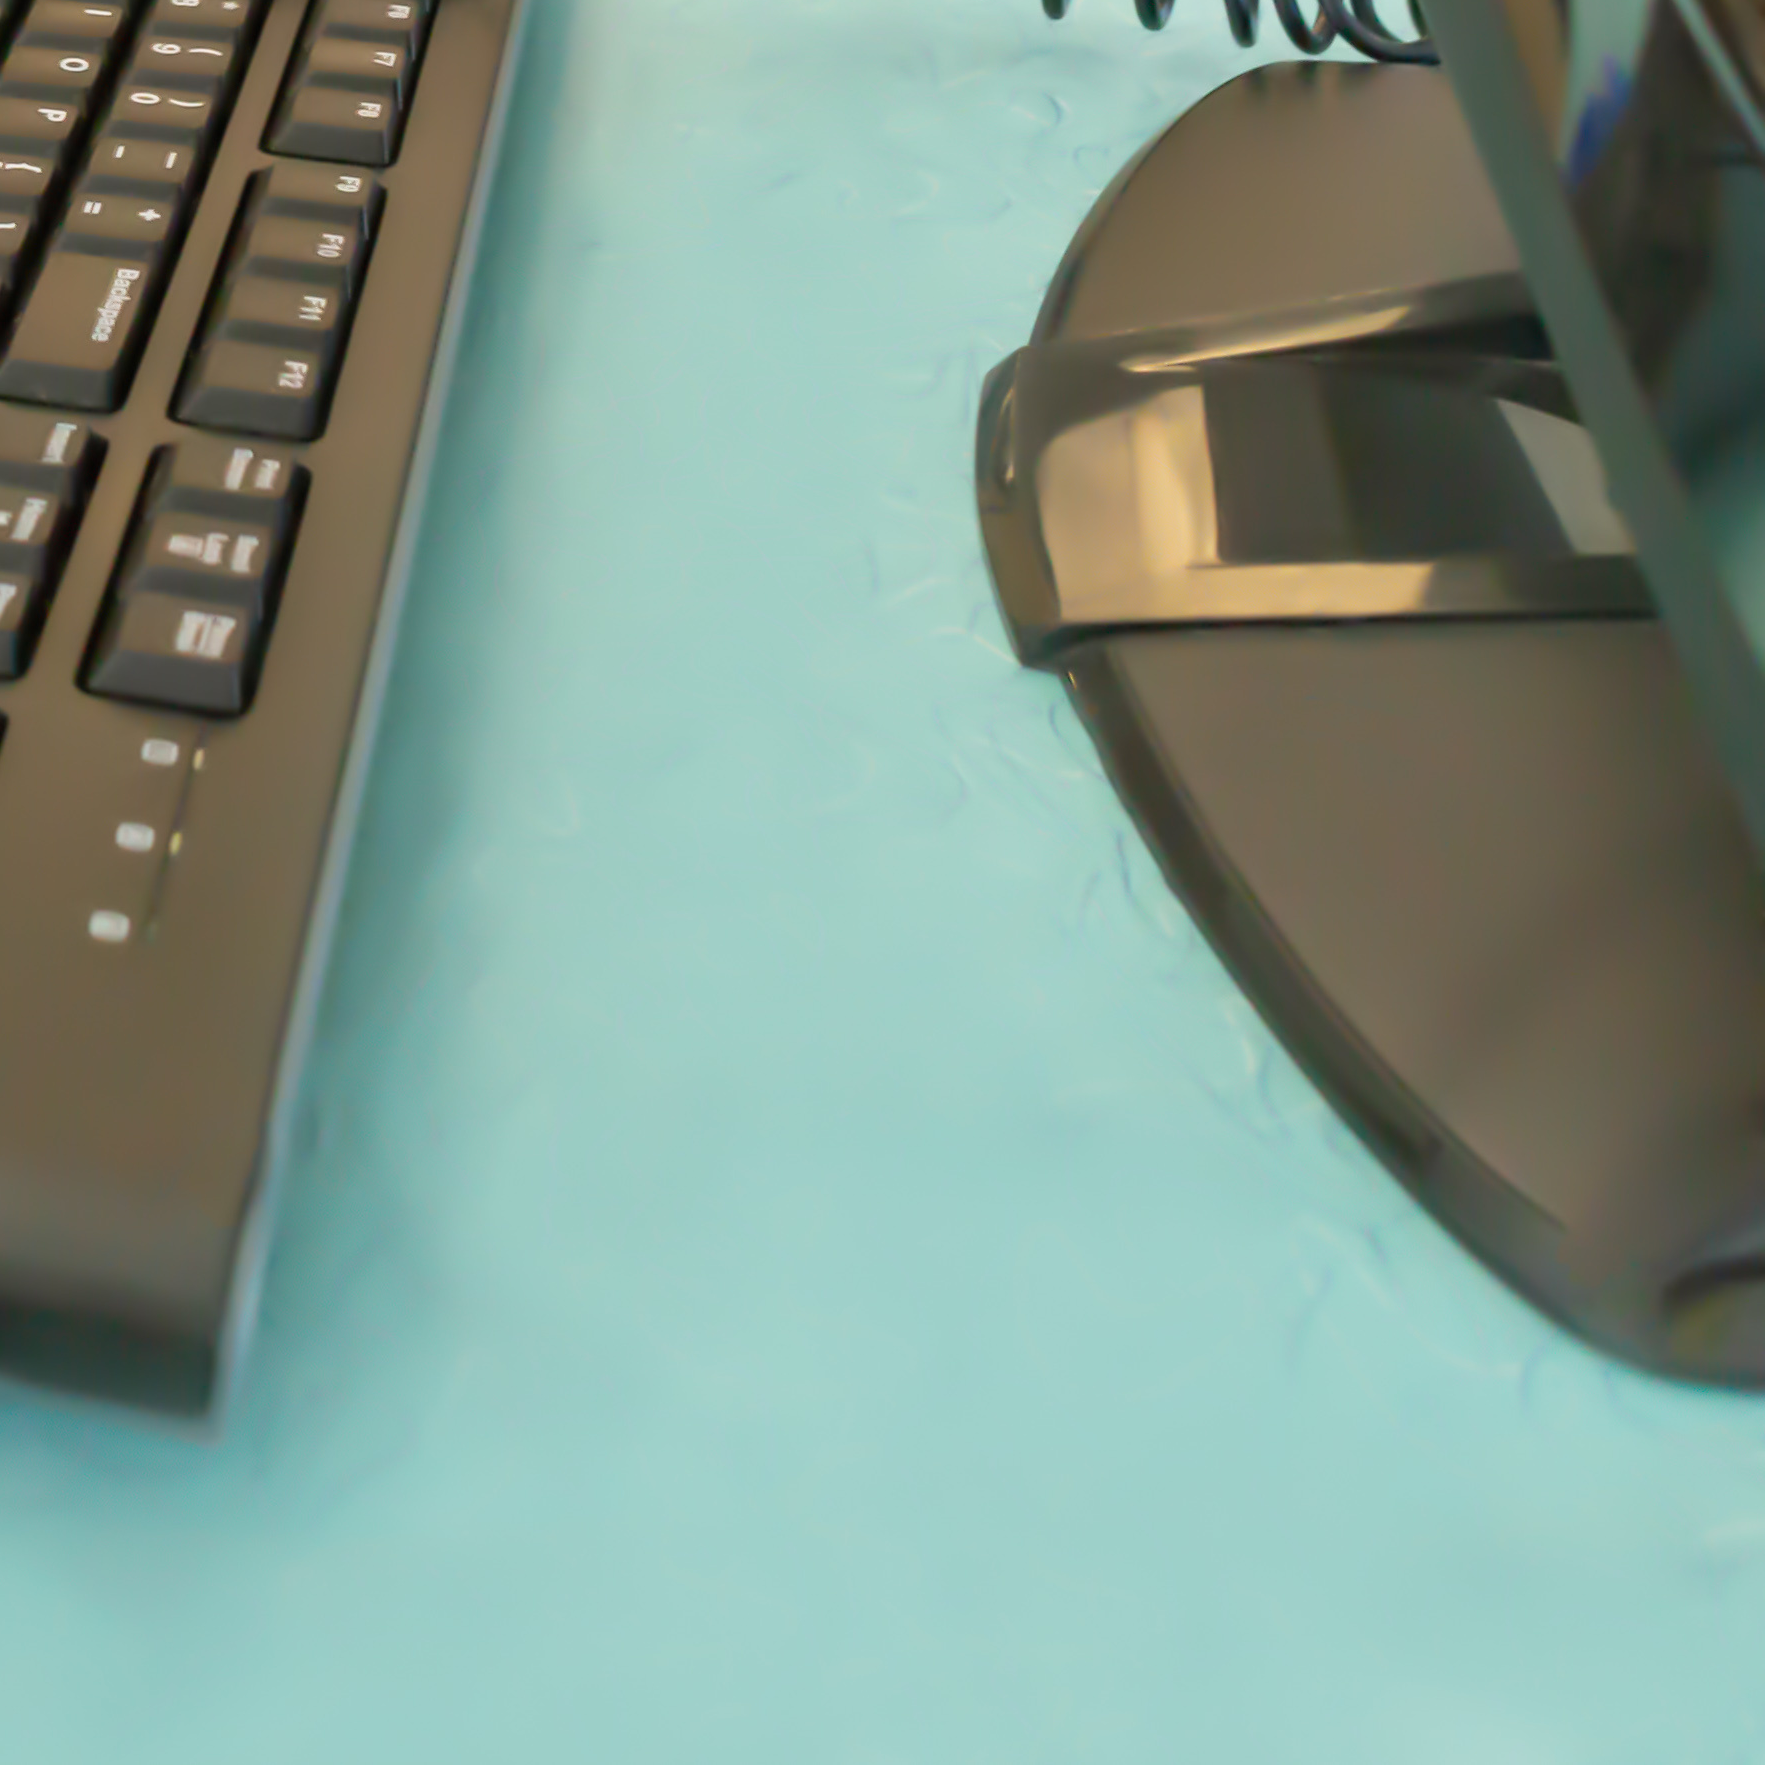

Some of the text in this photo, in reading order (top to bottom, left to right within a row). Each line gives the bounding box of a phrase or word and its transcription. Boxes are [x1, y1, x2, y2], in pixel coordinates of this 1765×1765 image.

[150, 42, 182, 56] 9
[58, 56, 90, 73] O
[369, 50, 398, 68] F7
[36, 107, 68, 123] P
[334, 175, 362, 194] F9
[316, 232, 346, 258] F10
[90, 267, 141, 343] Backspace
[298, 295, 327, 321] F11
[277, 359, 309, 390] F12
